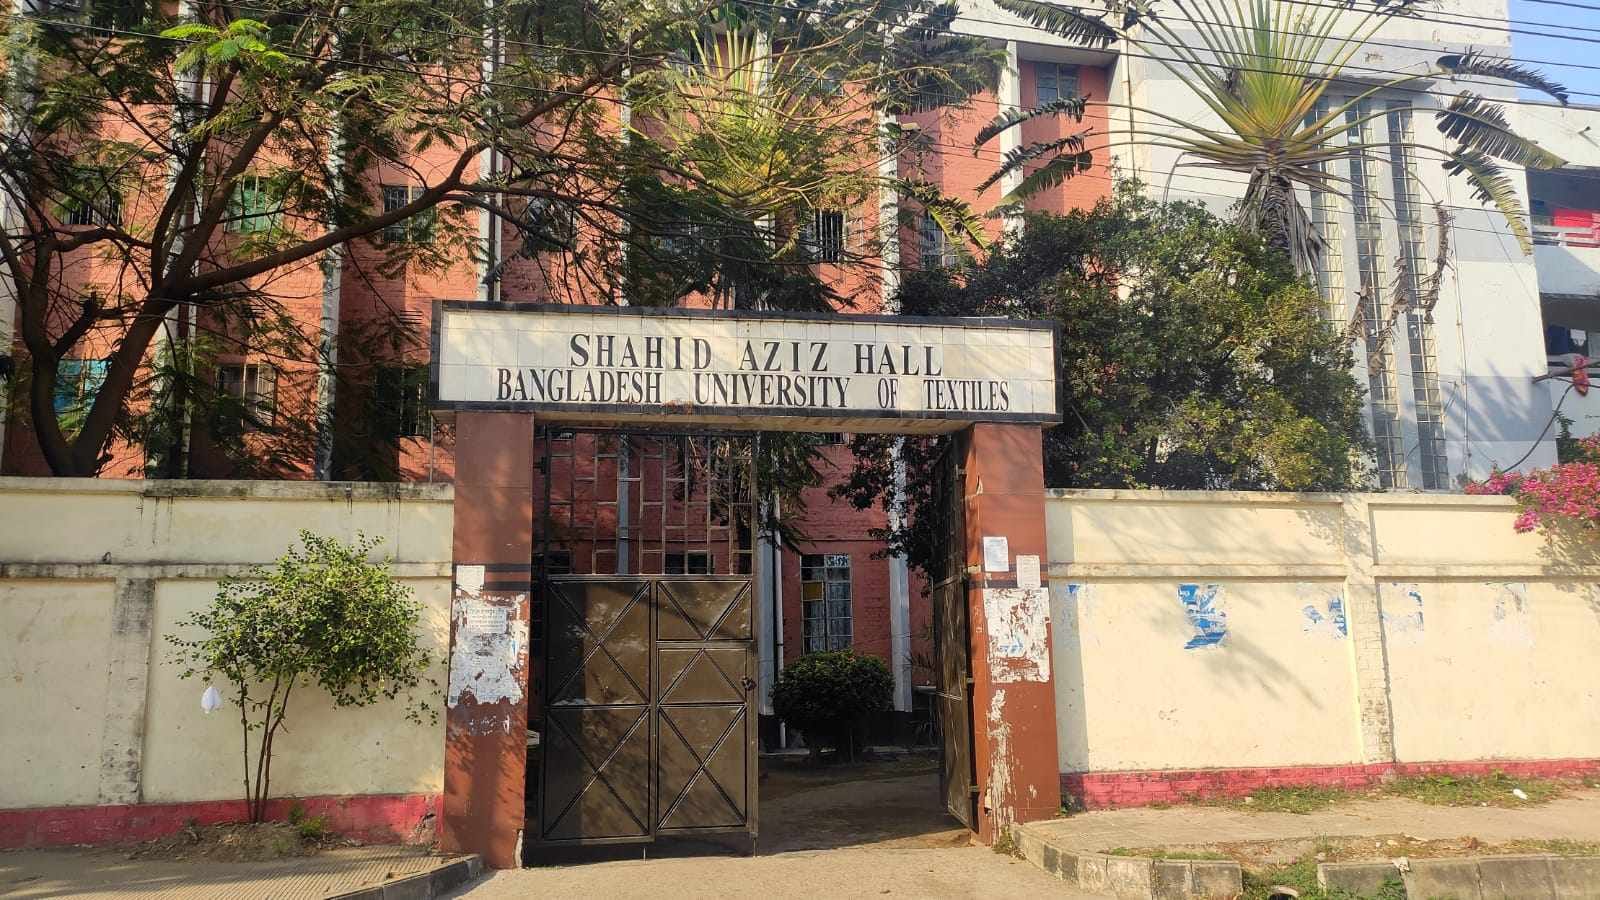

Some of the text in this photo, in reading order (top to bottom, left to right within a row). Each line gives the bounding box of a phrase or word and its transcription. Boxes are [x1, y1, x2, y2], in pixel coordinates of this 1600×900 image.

[570, 333, 942, 376] SHAHID AZIZ HALL
[497, 367, 1009, 411] BANGLADESH UNIVERSITY OF TEXTILES
